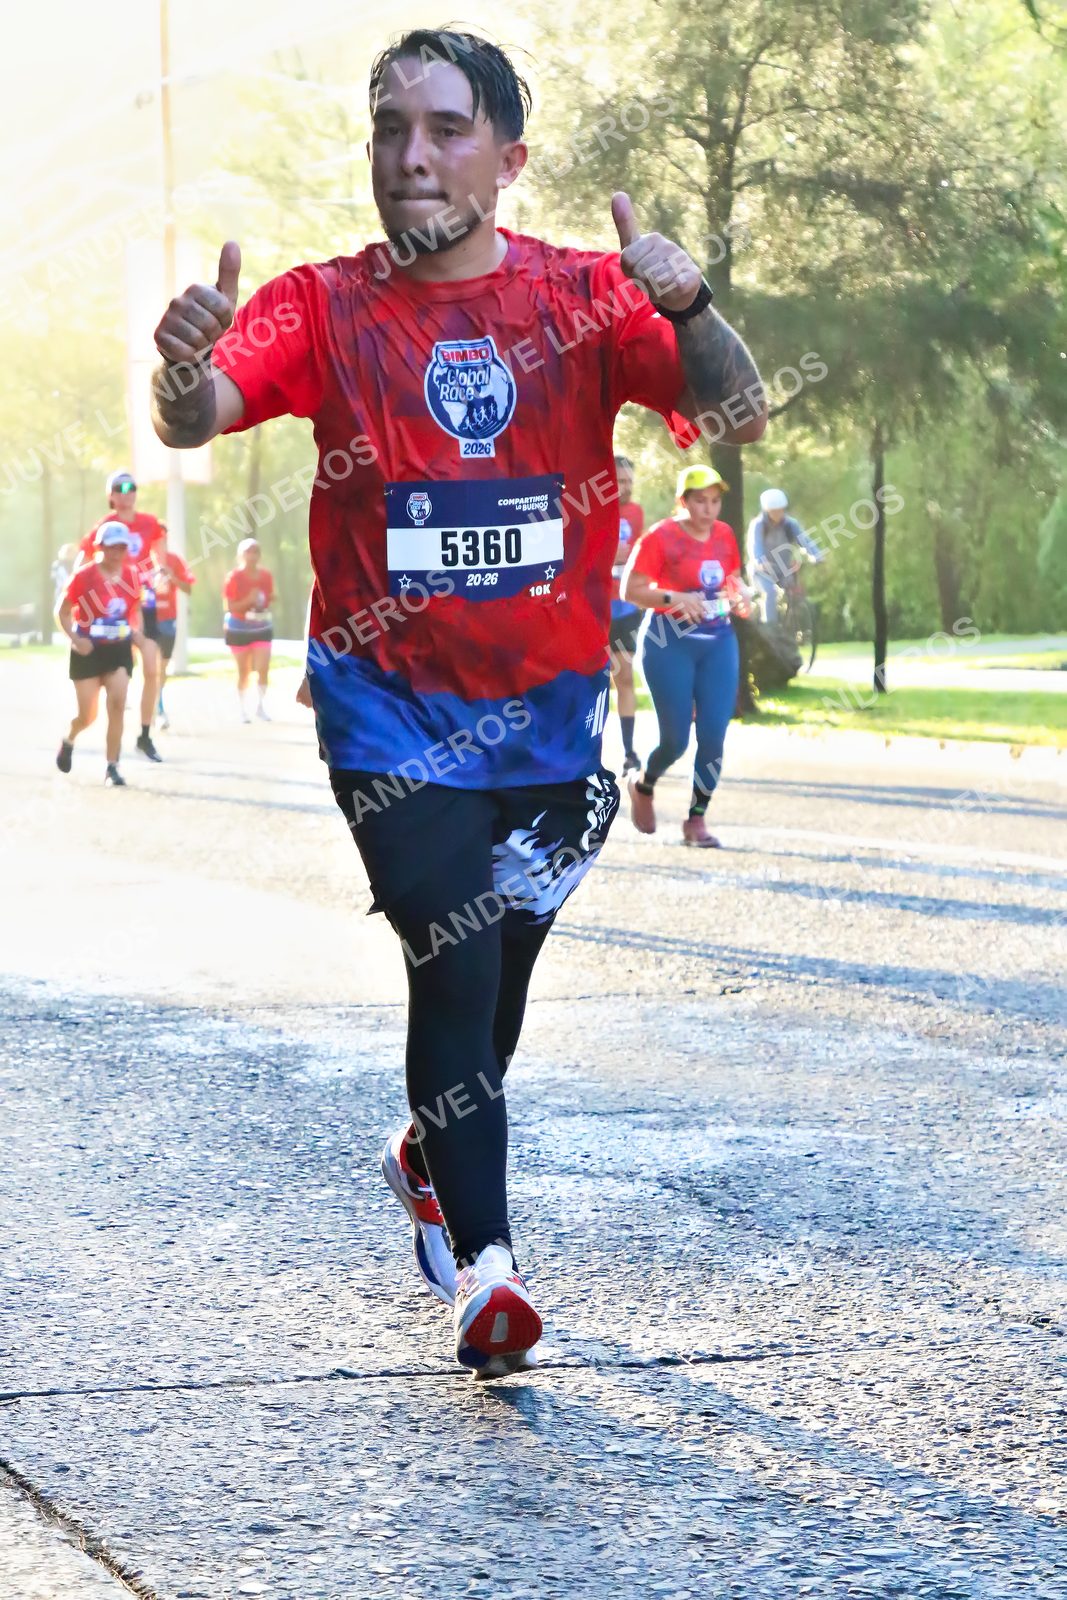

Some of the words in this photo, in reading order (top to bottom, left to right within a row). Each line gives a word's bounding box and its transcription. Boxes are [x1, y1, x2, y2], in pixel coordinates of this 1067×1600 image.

[440, 346, 490, 362] BIMBO
[447, 366, 490, 386] Global
[440, 383, 475, 401] Race
[463, 442, 492, 455] 2026
[497, 494, 549, 506] COMPARTIMOS
[441, 527, 522, 567] 5360
[529, 583, 551, 597] 10K
